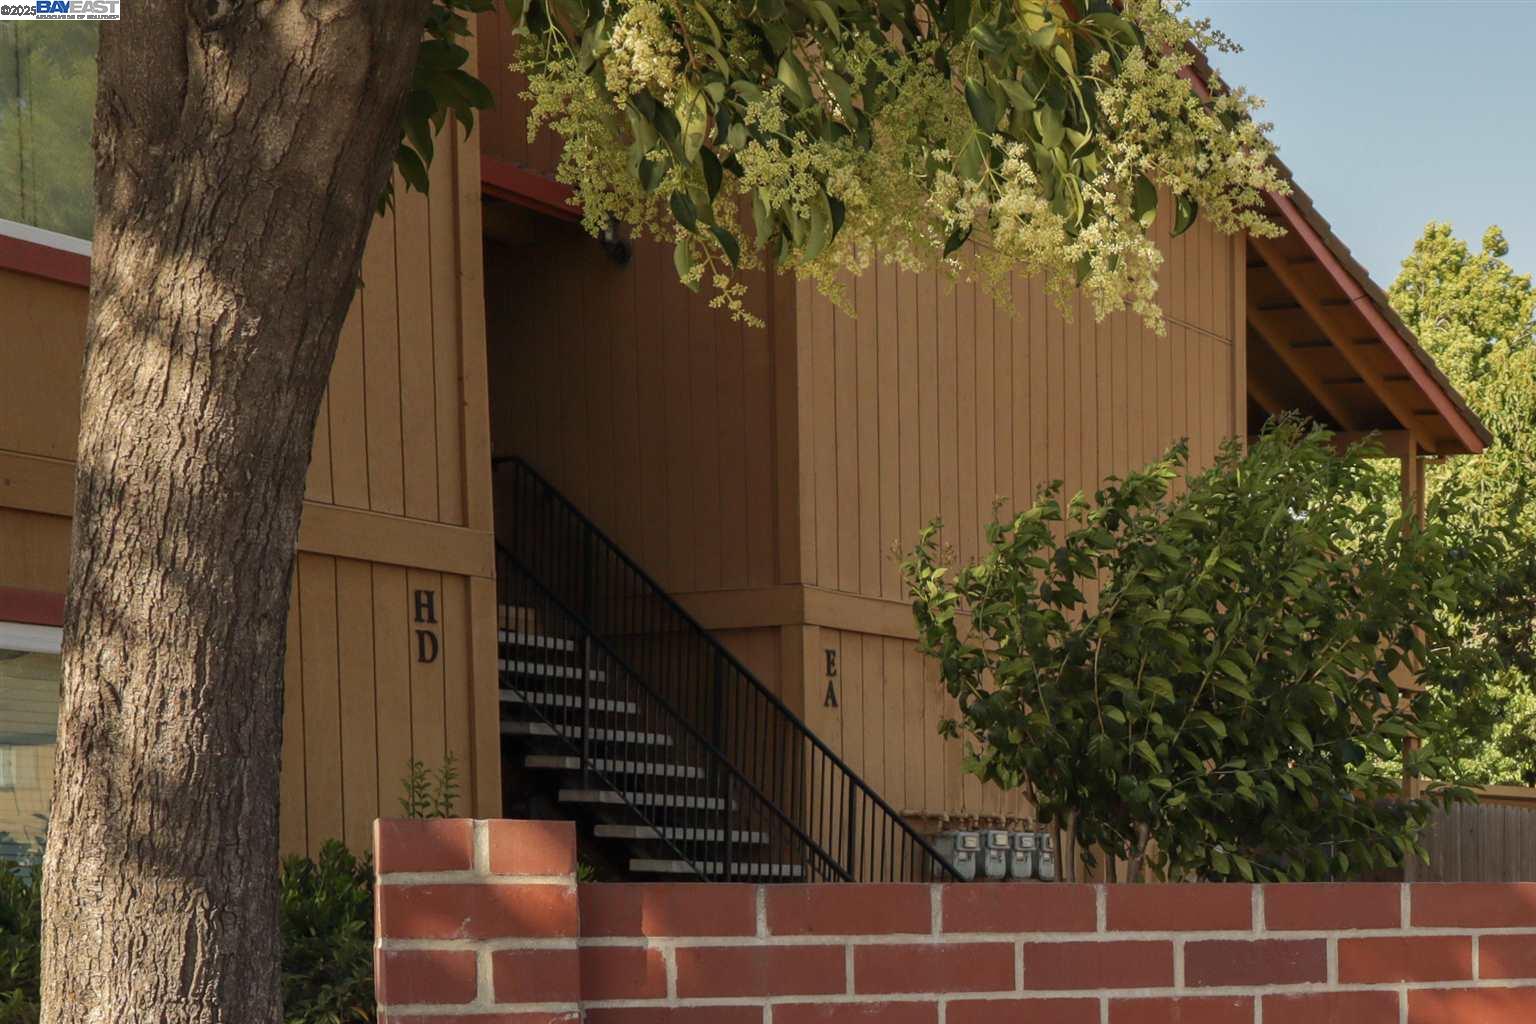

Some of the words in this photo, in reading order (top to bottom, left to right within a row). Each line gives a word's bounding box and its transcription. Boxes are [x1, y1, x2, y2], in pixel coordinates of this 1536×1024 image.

[414, 590, 437, 624] H
[415, 629, 438, 663] D
[825, 649, 837, 677] E
[824, 679, 839, 707] A
